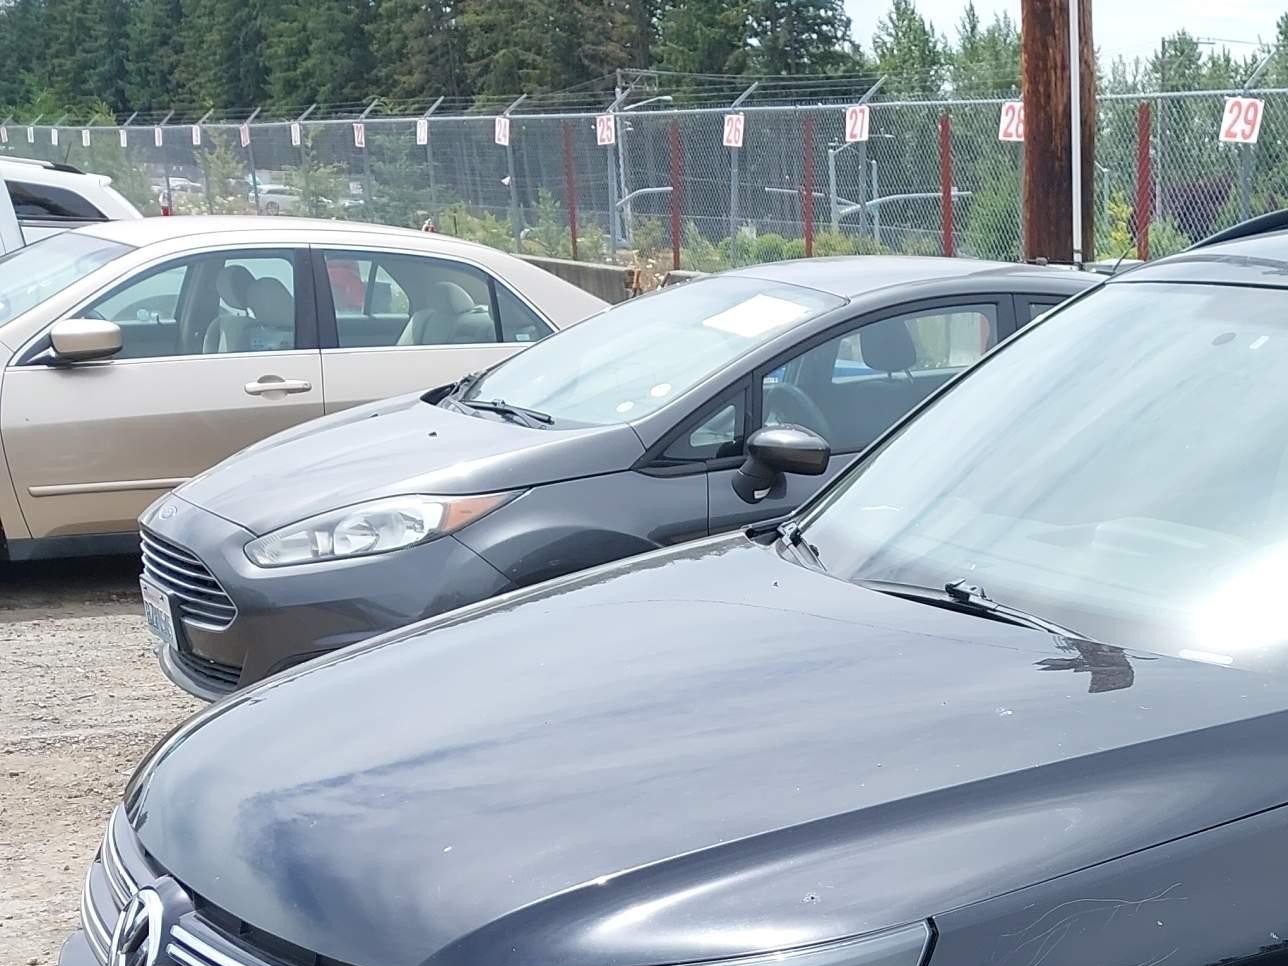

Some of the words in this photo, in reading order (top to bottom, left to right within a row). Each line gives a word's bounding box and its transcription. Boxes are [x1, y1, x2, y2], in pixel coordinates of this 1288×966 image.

[600, 117, 613, 143] 25
[726, 118, 742, 144] 26
[850, 107, 867, 139] 27
[1225, 100, 1259, 140] 29
